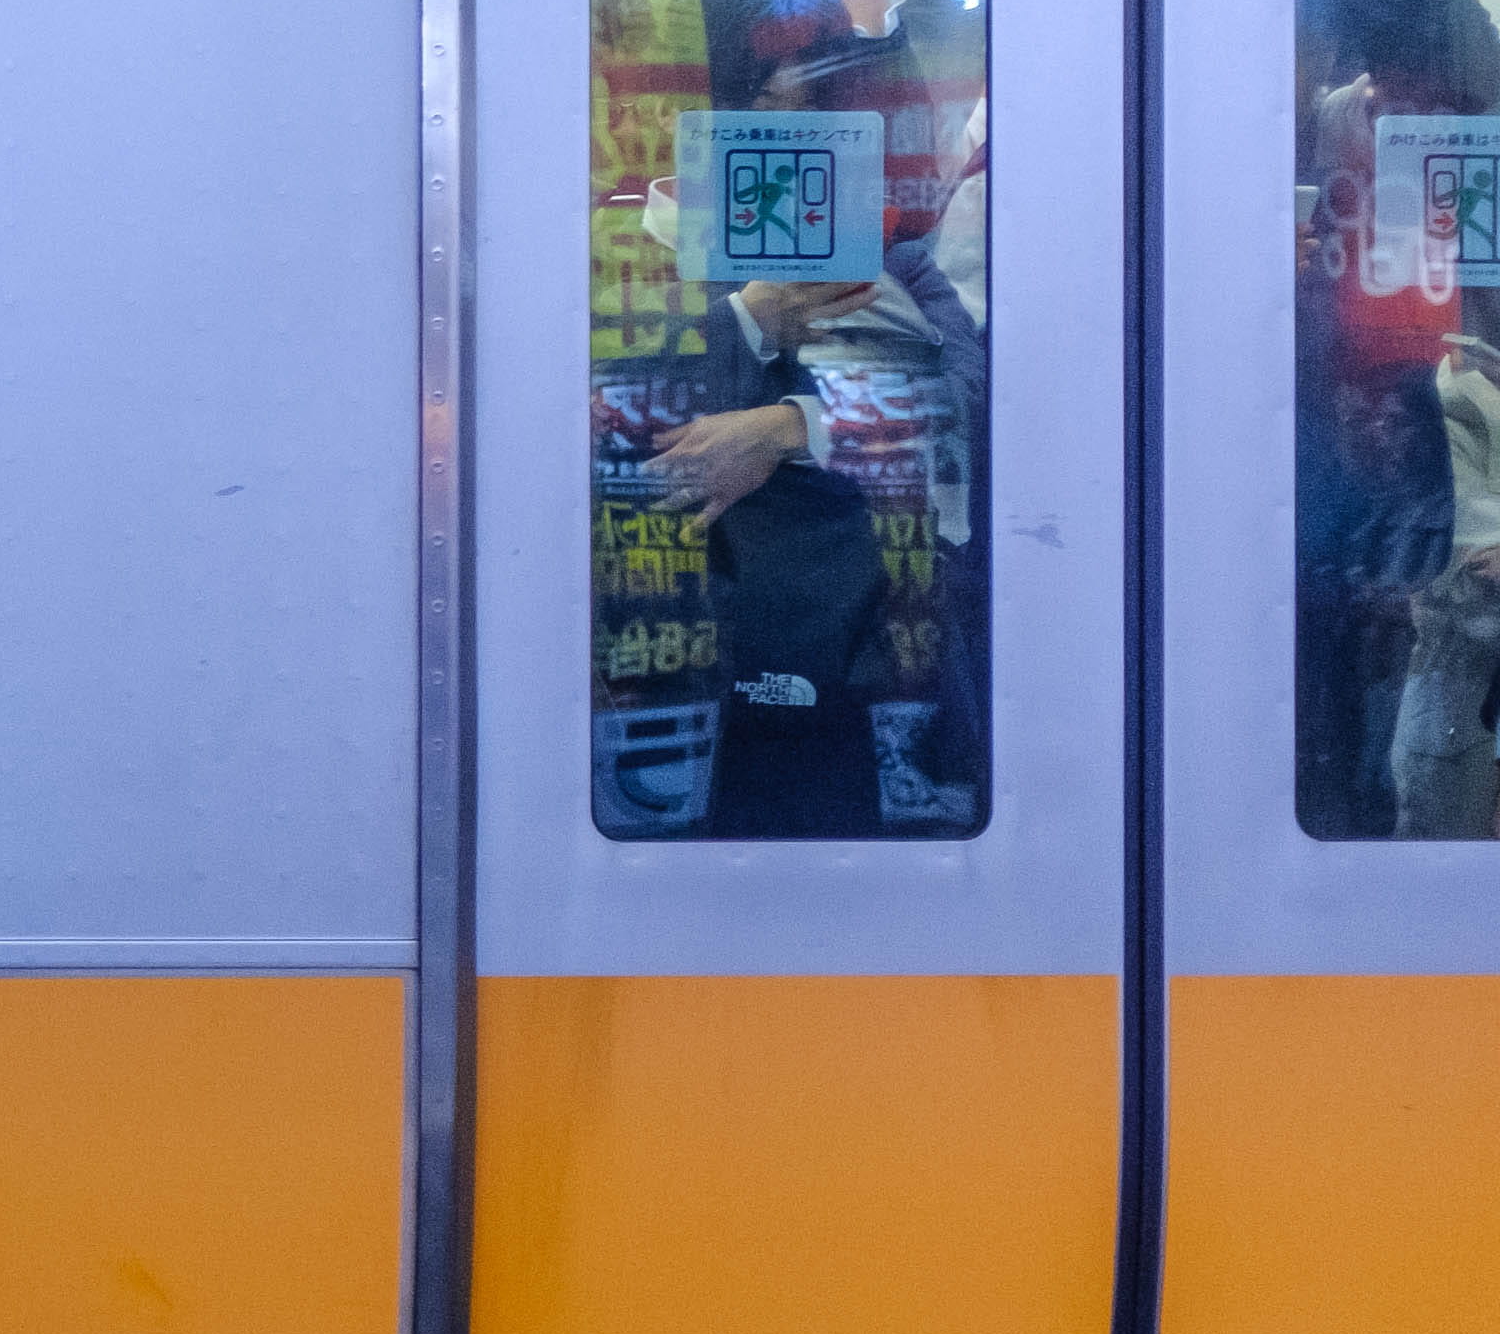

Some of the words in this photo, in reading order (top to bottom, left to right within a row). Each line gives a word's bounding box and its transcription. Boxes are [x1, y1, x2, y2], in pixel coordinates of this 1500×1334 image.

[761, 672, 792, 684] THE
[734, 680, 789, 695] NORTH
[748, 693, 790, 705] FACE
